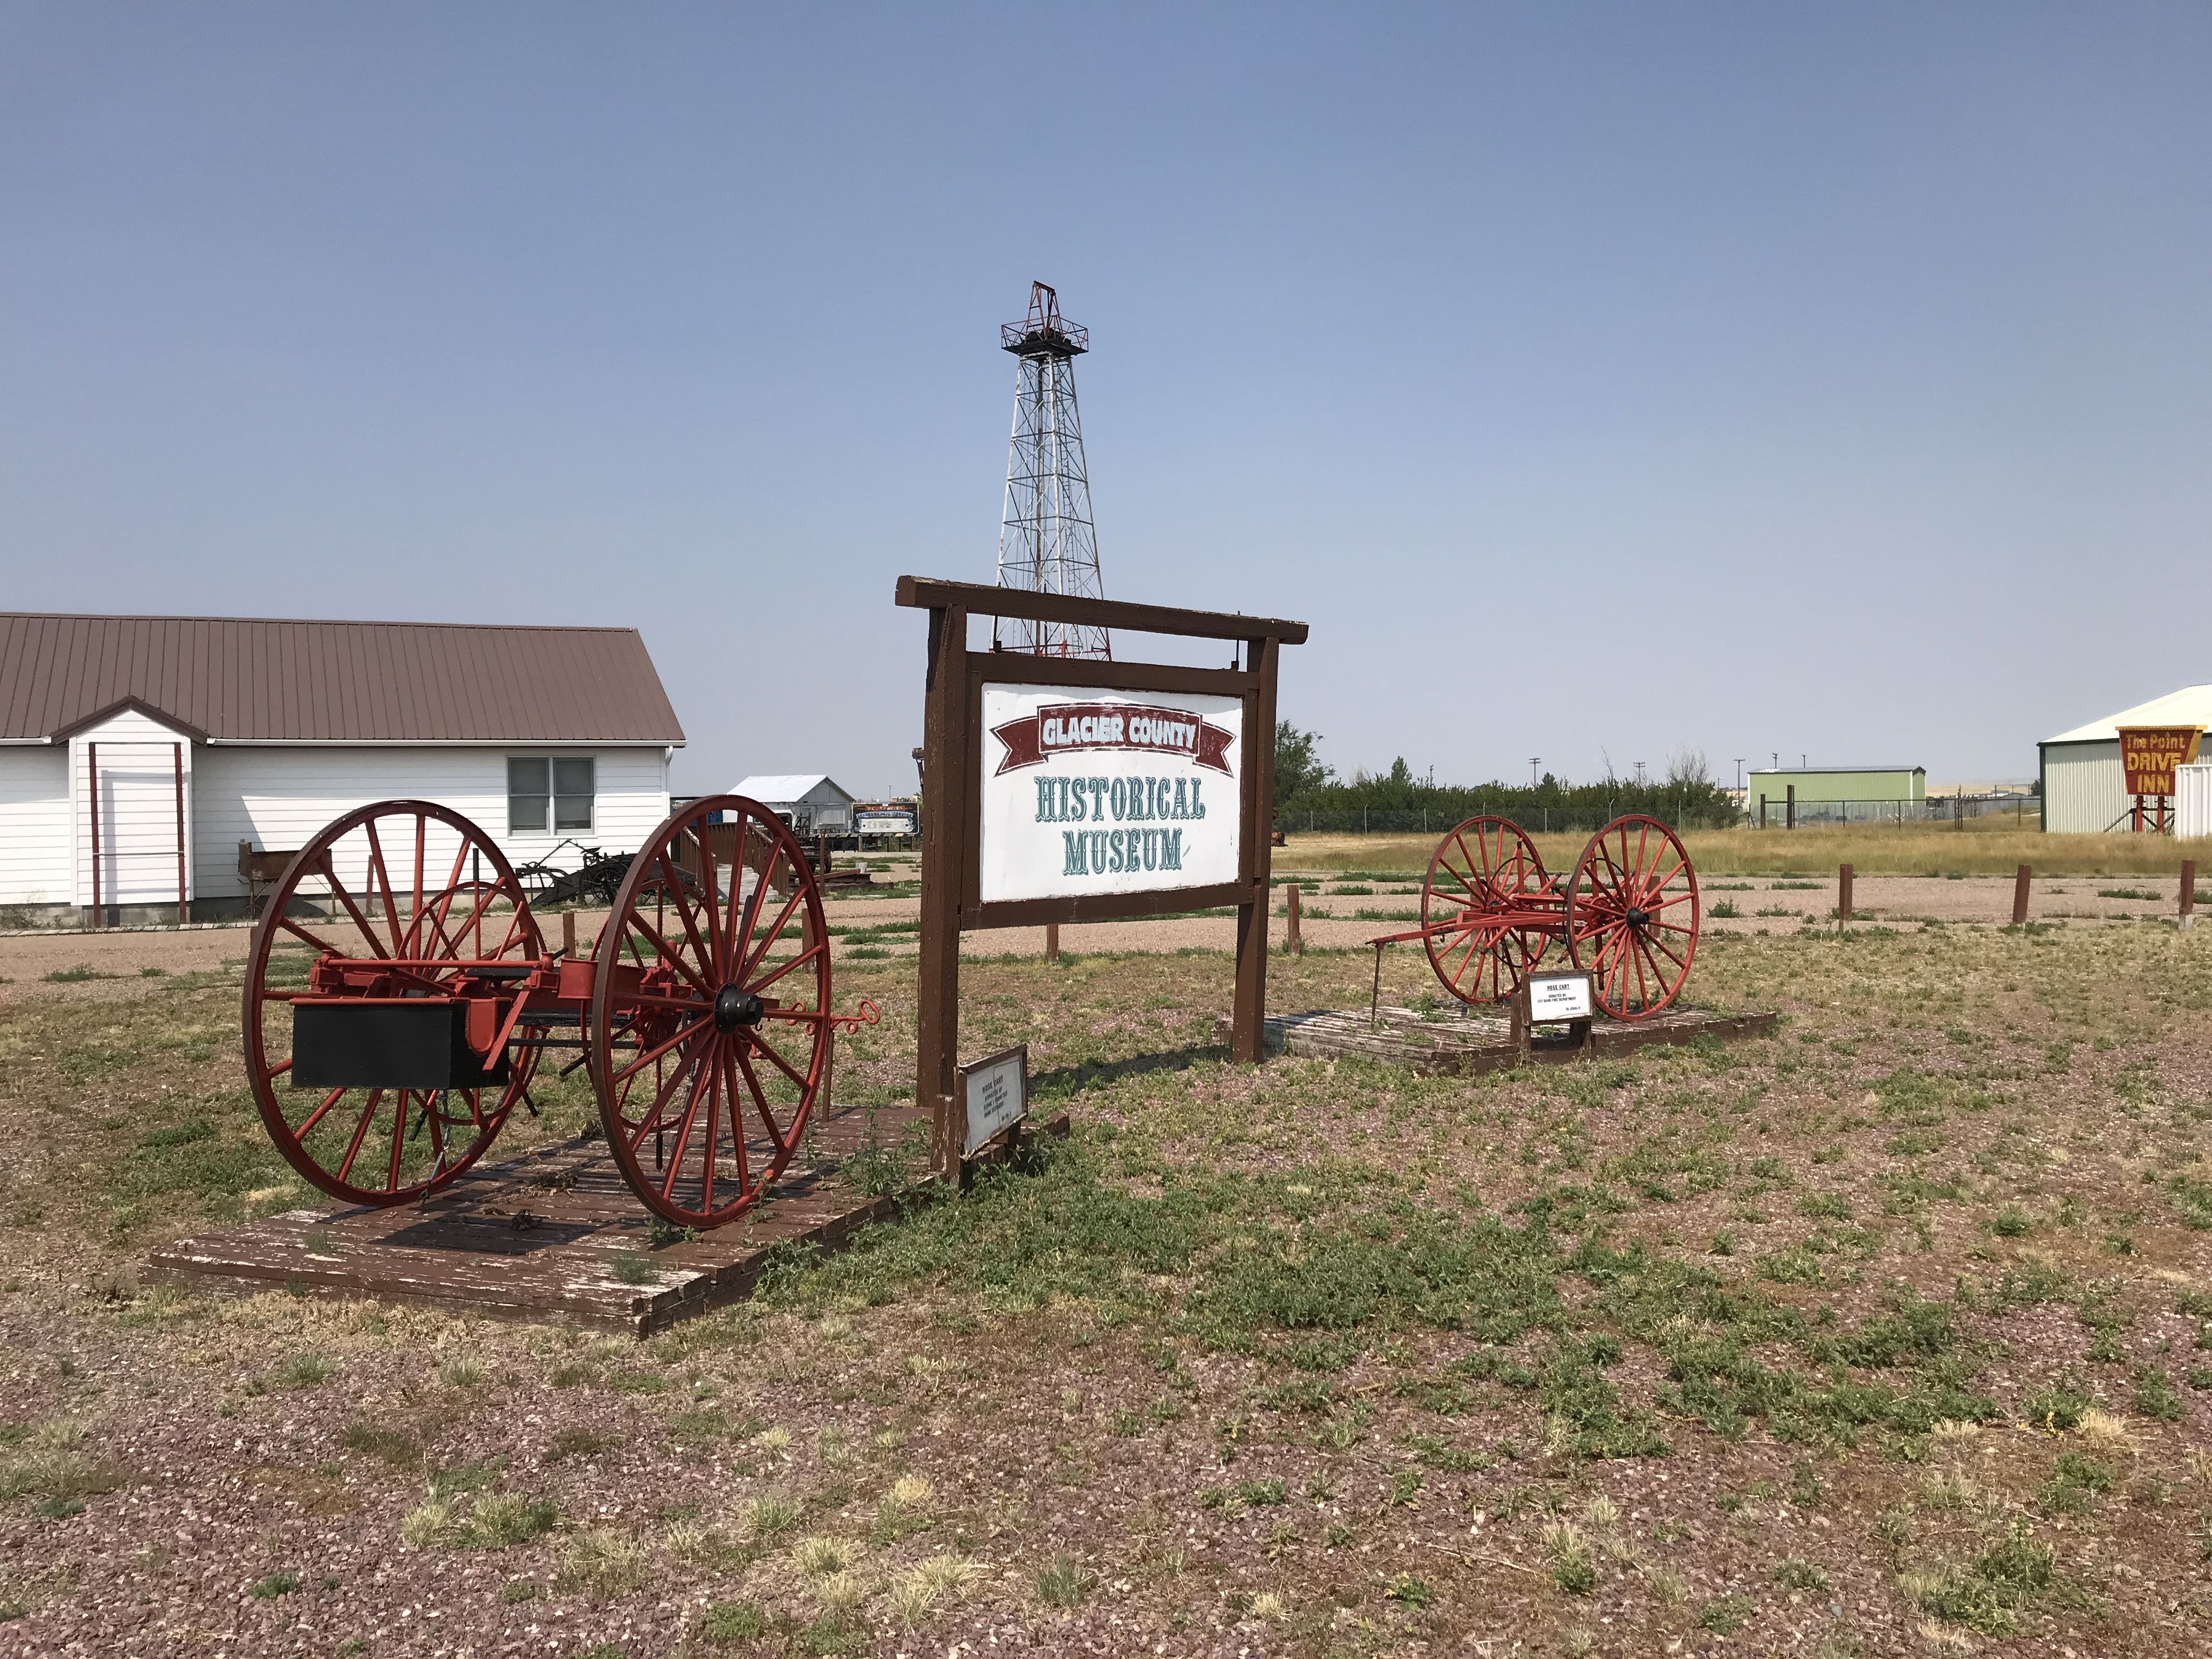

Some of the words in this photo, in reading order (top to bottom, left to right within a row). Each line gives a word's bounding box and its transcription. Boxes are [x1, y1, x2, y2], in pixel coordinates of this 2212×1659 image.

[1043, 716, 1125, 746] GLACIER
[1128, 717, 1197, 748] COUNTY
[2126, 733, 2147, 749] The
[2149, 732, 2186, 749] Point
[2127, 752, 2182, 771] DRIVE
[2137, 774, 2169, 793] INN
[1034, 776, 1205, 823] HISTORICAL
[1062, 827, 1182, 876] MUSEUM
[983, 1082, 992, 1093] HOSE
[994, 1075, 1003, 1086] CART
[985, 1089, 998, 1102] DONATED
